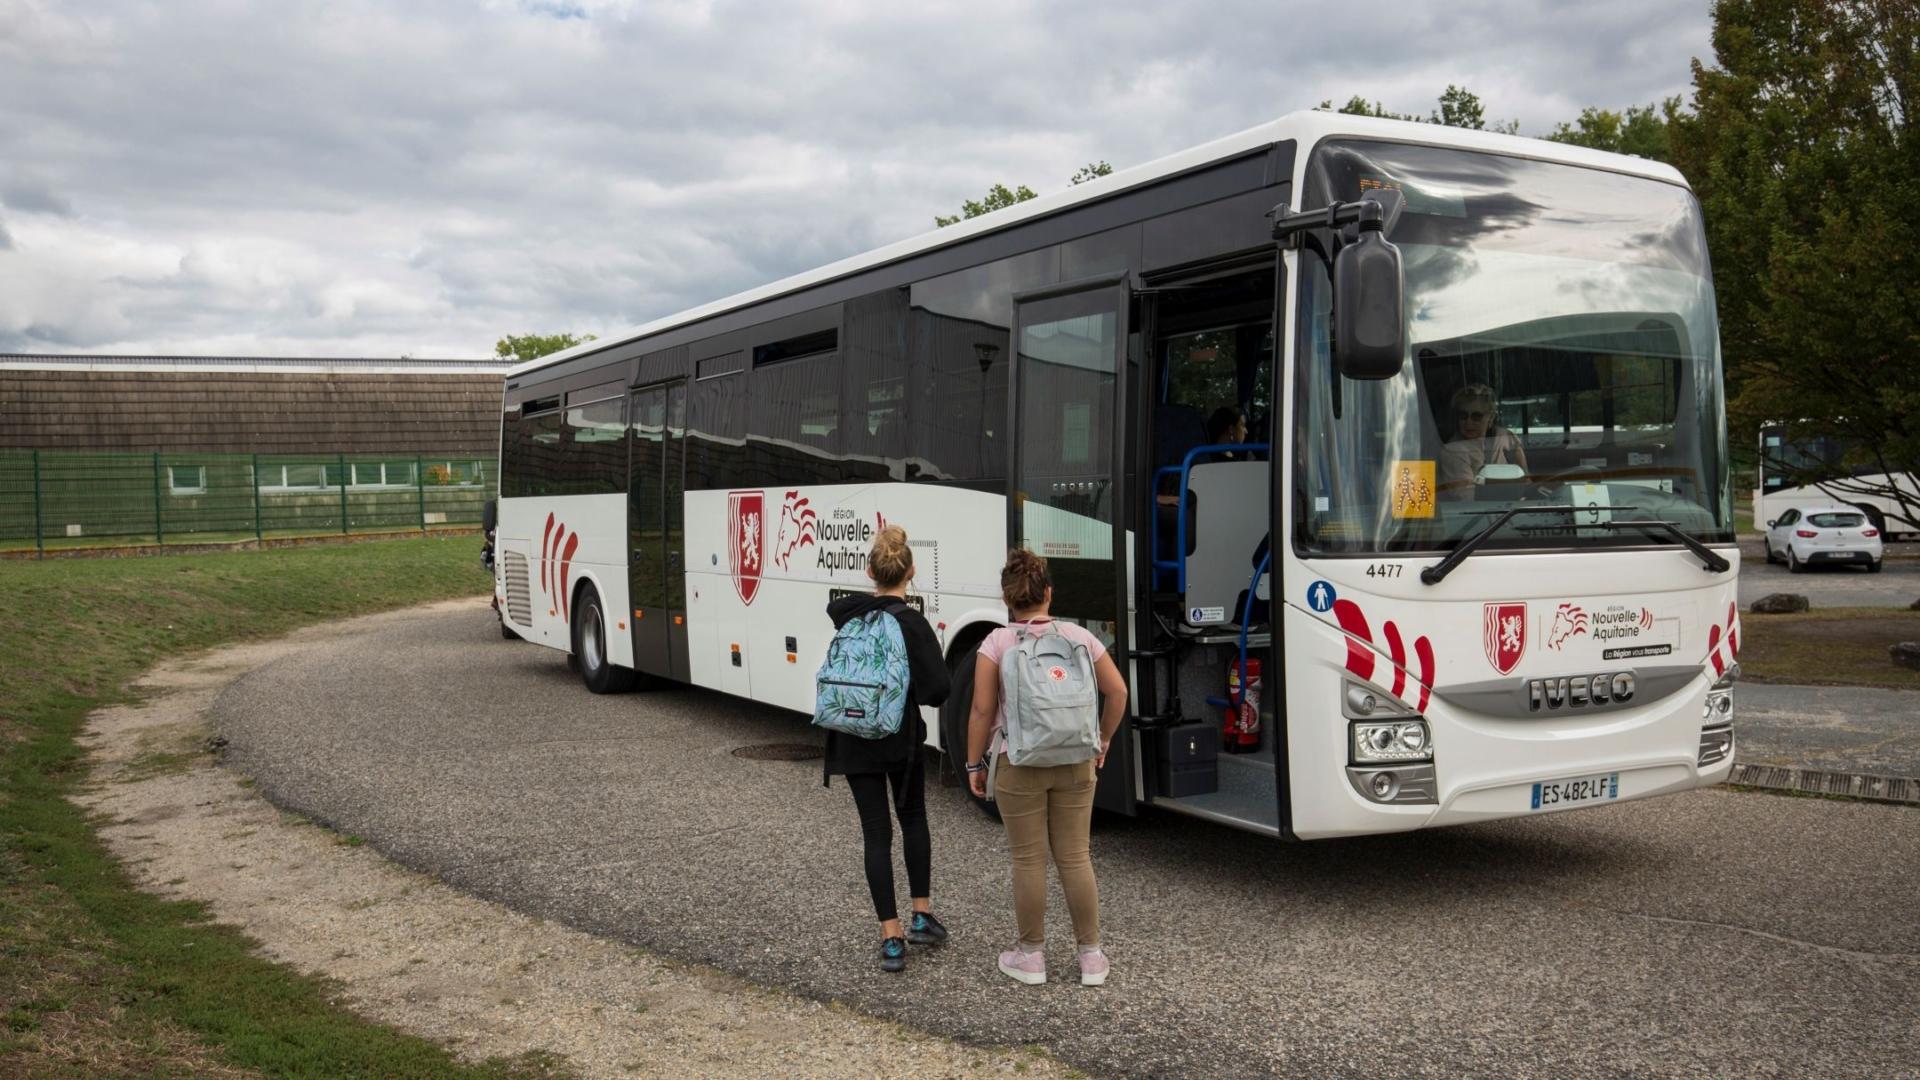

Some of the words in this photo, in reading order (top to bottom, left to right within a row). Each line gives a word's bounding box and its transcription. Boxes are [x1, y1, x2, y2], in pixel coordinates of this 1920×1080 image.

[833, 509, 855, 519] RÉGION
[1588, 502, 1599, 524] 9
[817, 518, 875, 542] Nouvelle-
[1366, 564, 1403, 578] 4477
[1592, 609, 1640, 625] Nouvelle-
[1592, 624, 1640, 642] Aquitaine
[1605, 650, 1613, 659] La
[1613, 649, 1631, 659] Région
[1644, 646, 1670, 656] transporte
[1529, 672, 1635, 712] IVECO
[1542, 778, 1608, 805] ES-482-LF
